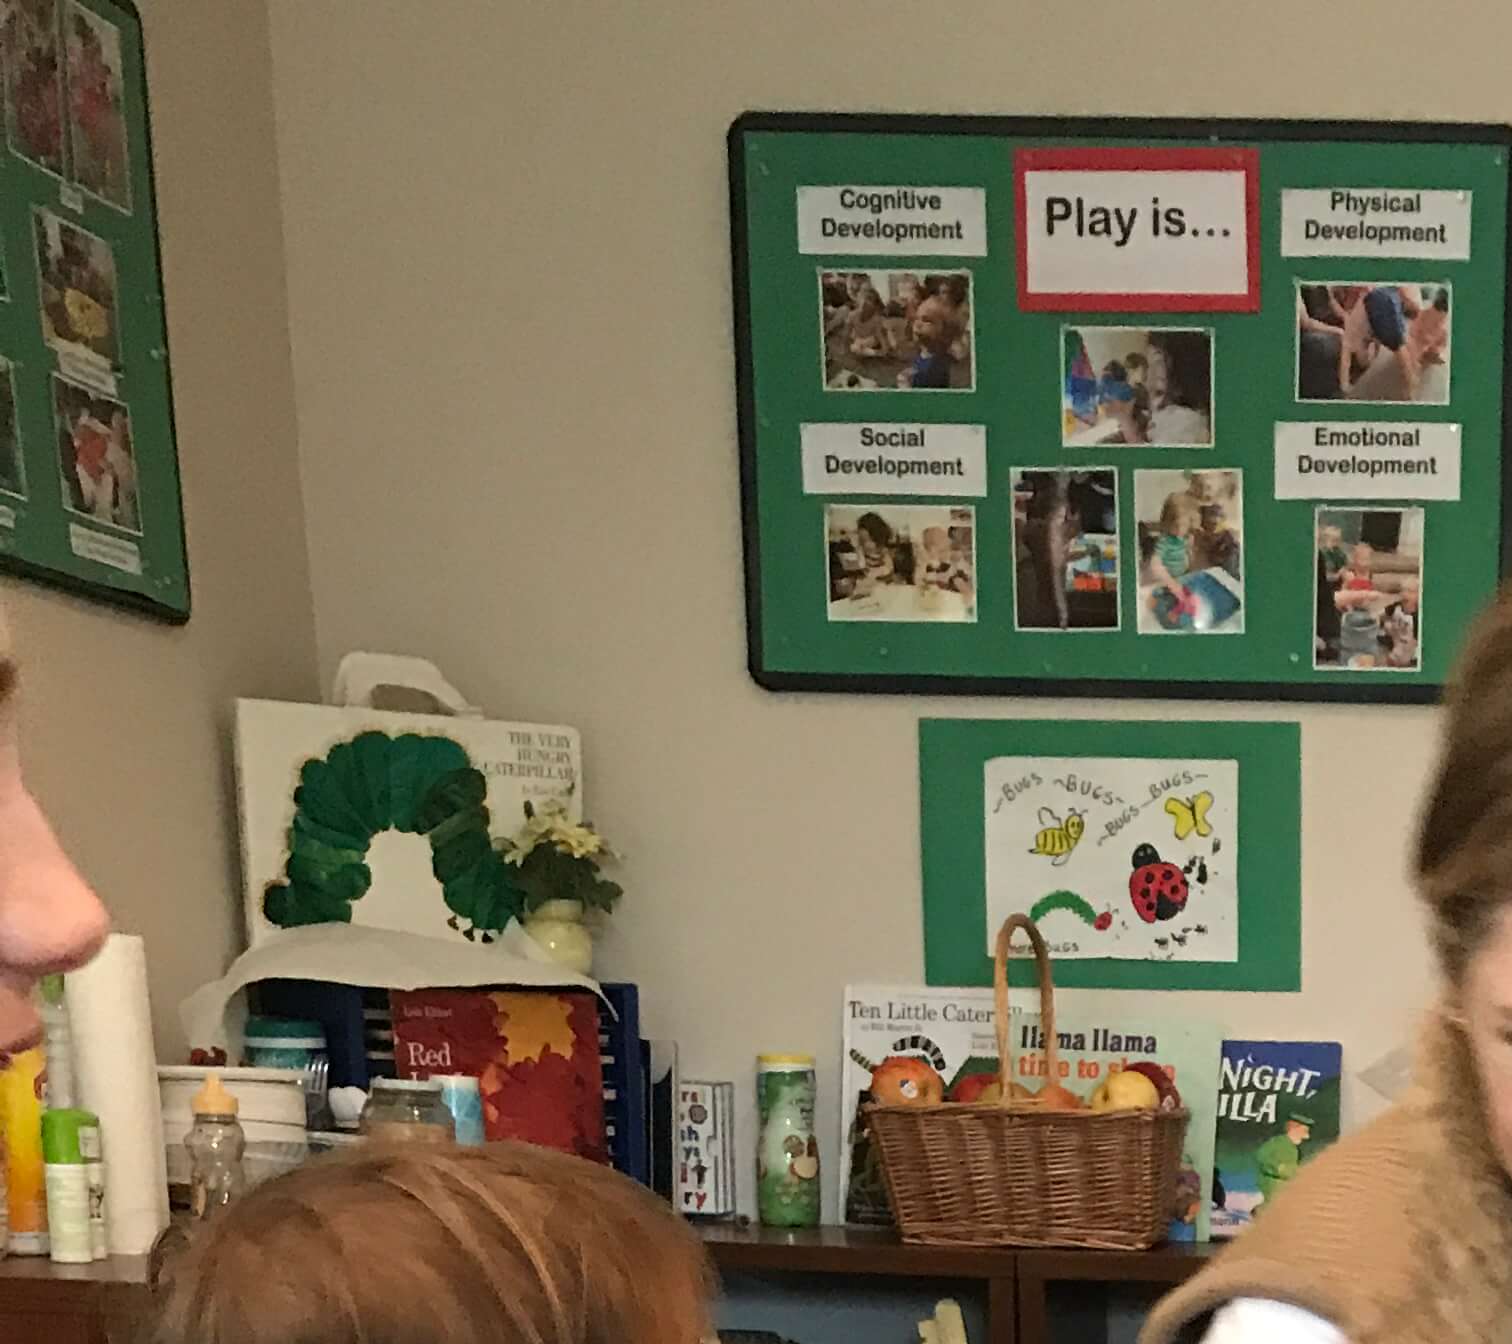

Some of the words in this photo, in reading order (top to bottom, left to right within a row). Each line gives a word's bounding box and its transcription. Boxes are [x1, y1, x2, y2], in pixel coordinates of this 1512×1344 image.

[839, 188, 942, 214] Cognitive
[1330, 191, 1422, 216] Physical
[821, 217, 964, 243] Development
[1045, 196, 1138, 247] Play
[1151, 196, 1231, 238] is...
[1304, 219, 1448, 245] Development
[860, 427, 926, 448] Social
[1314, 426, 1421, 447] Emotional
[824, 454, 965, 478] Development
[1297, 454, 1438, 478] Development
[1002, 772, 1044, 802] BUGS
[1065, 773, 1116, 806] BUGS
[1104, 805, 1140, 839] BUGS
[1149, 769, 1195, 800] BUGS
[849, 1000, 881, 1020] Ten
[887, 1001, 938, 1022] Little
[942, 1003, 1003, 1023] Cater
[1093, 1028, 1157, 1054] llama
[407, 1041, 452, 1068] Red
[1078, 1059, 1100, 1079] to
